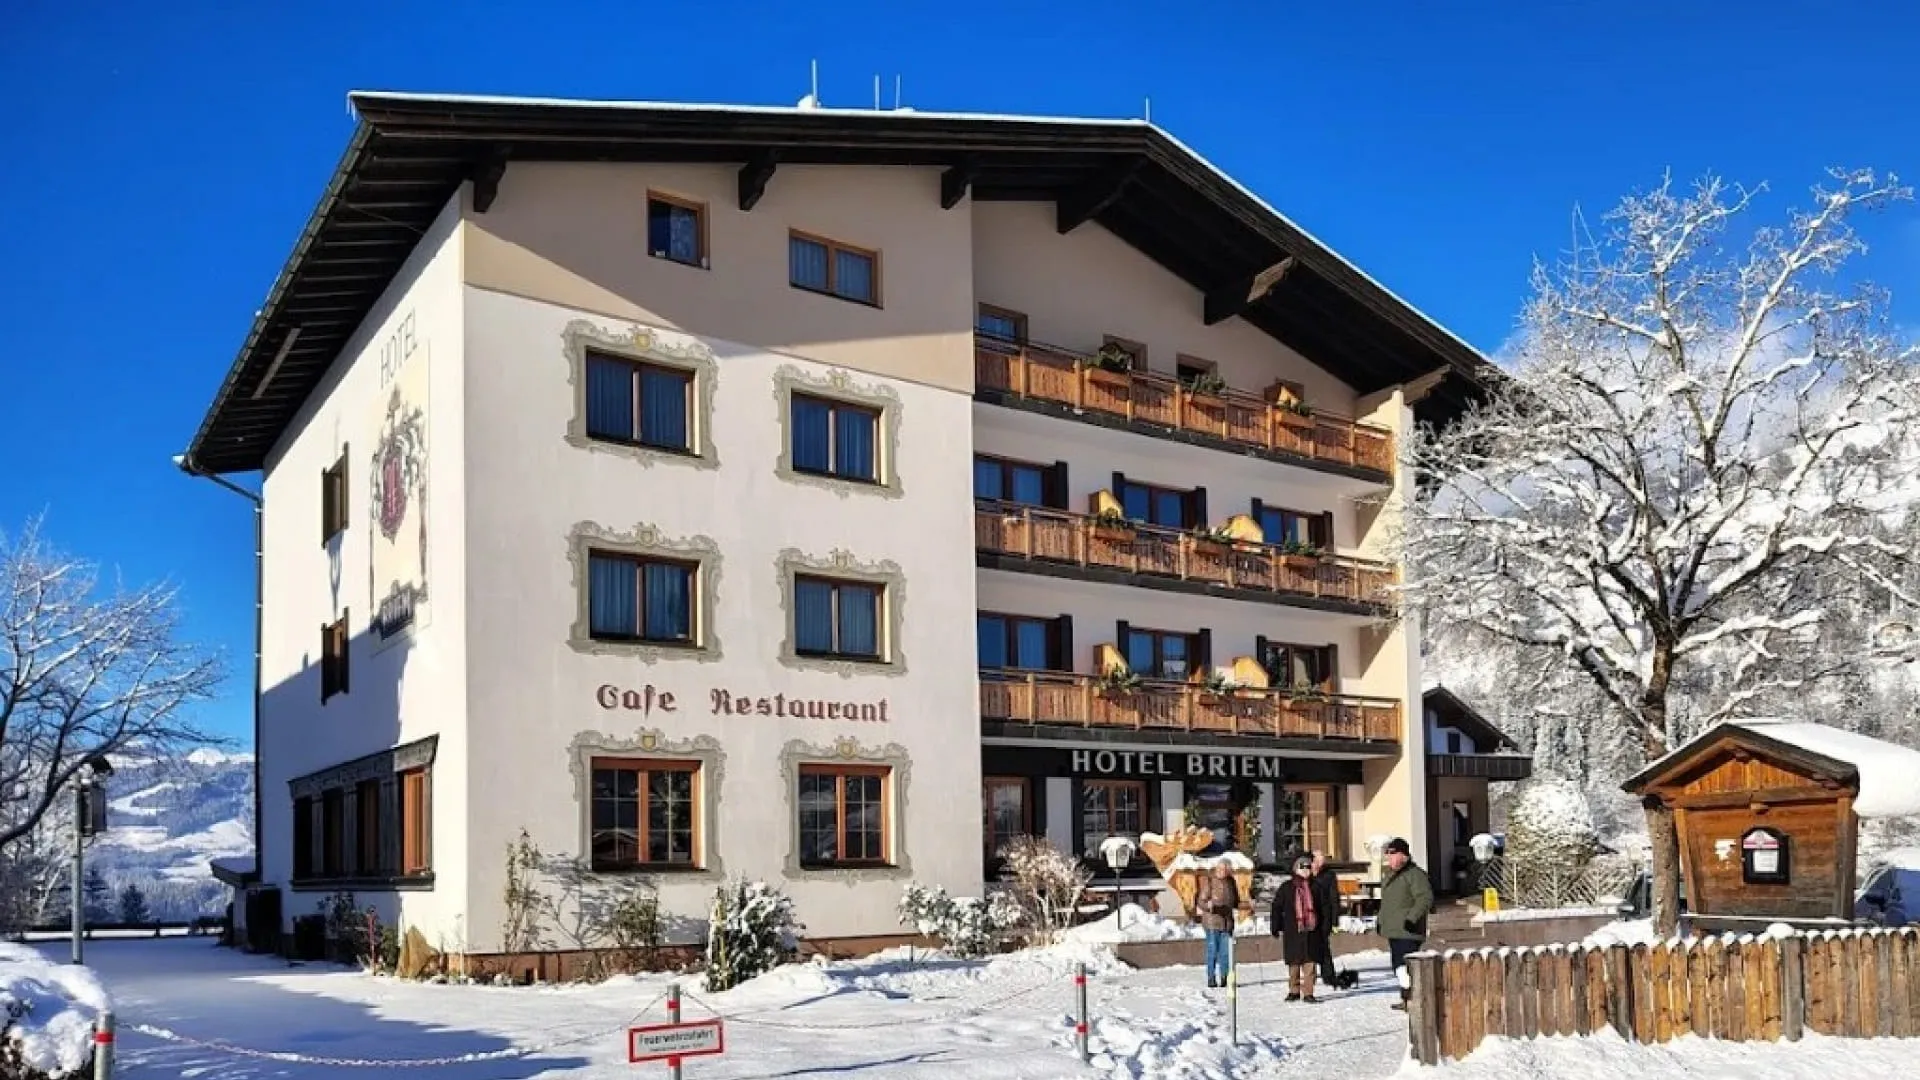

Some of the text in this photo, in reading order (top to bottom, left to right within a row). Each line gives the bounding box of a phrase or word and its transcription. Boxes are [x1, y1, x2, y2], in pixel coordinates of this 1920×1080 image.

[380, 307, 418, 391] HOTEL
[710, 687, 889, 723] Restaurant
[1072, 750, 1281, 778] HOTEL BRIEM
